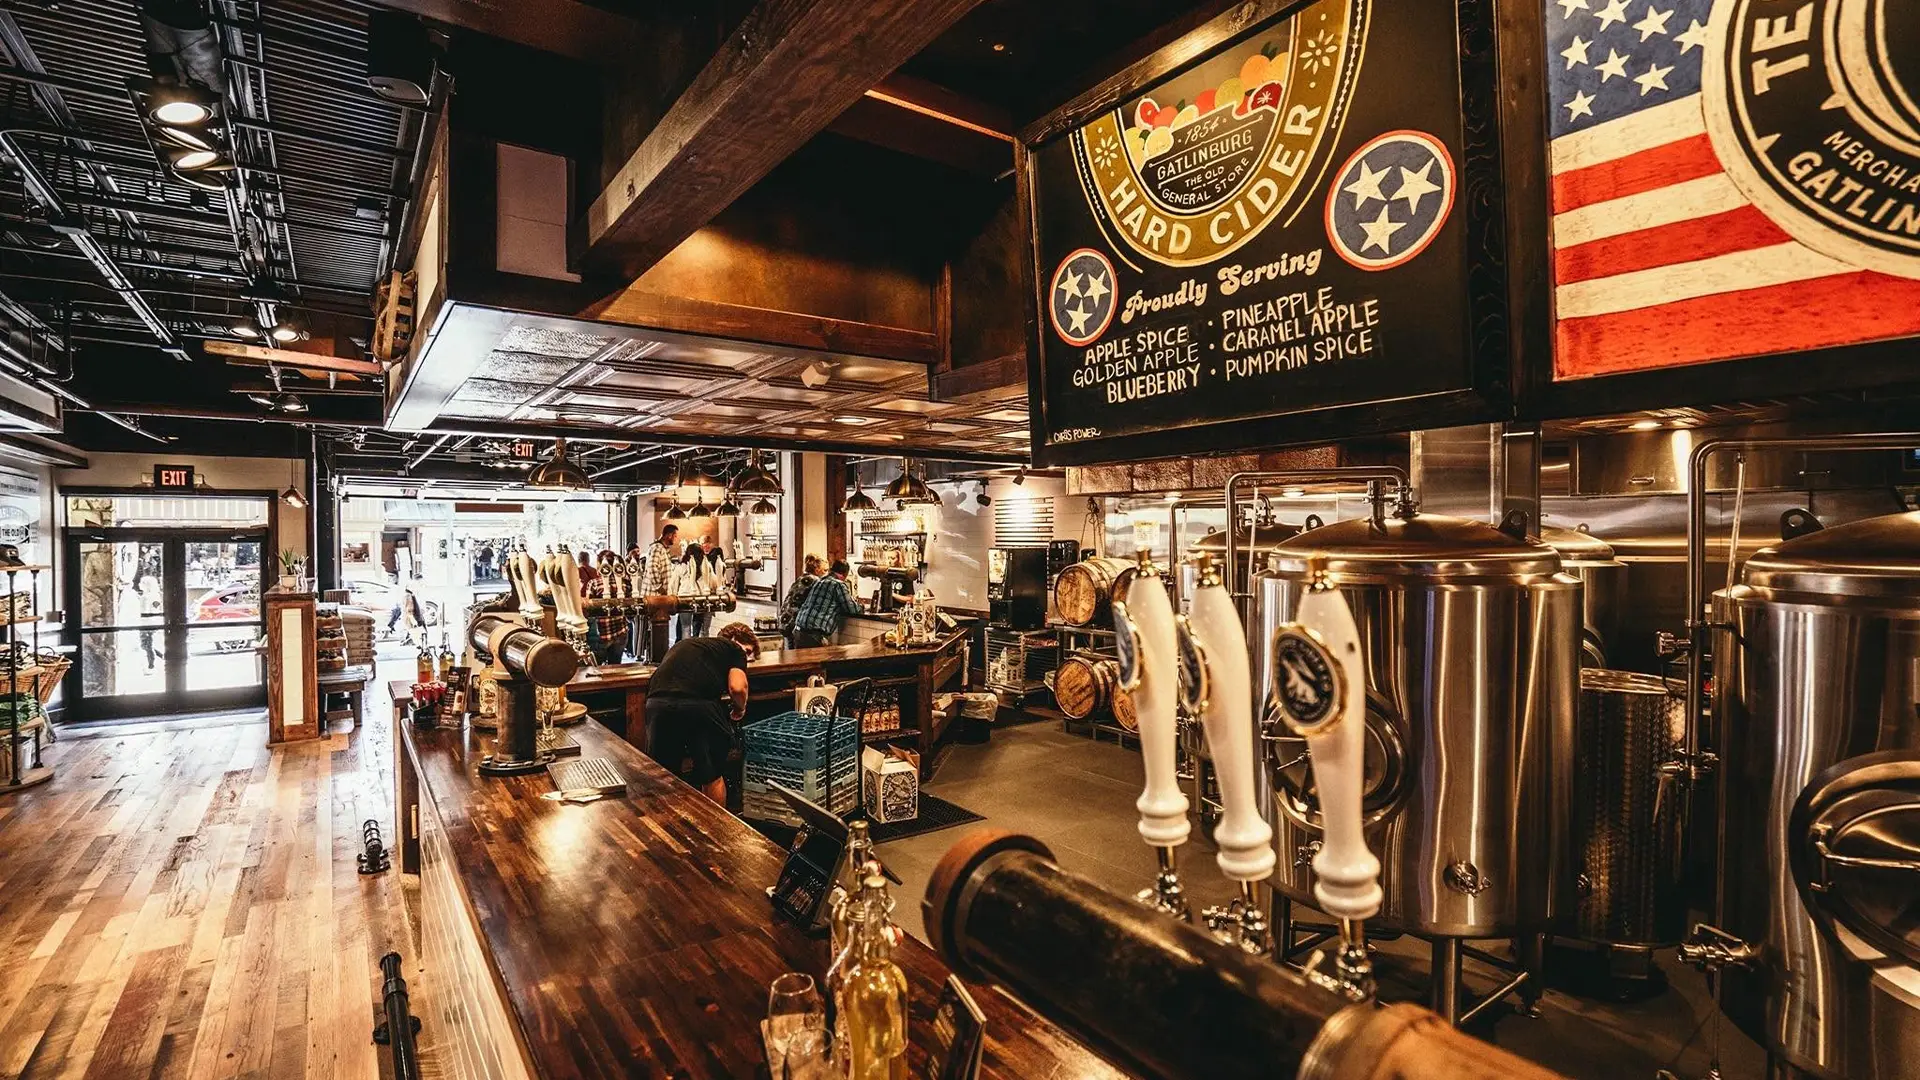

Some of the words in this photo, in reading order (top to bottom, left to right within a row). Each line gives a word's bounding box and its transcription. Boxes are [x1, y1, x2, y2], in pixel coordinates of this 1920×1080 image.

[1184, 116, 1220, 145] 1854
[1157, 129, 1252, 180] GATLINBURG
[1184, 173, 1203, 188] THE
[1205, 166, 1225, 180] OLD
[1110, 176, 1192, 254] HARD
[1209, 103, 1322, 245] CIDER
[1161, 188, 1212, 205] GENERAL
[1215, 157, 1250, 193] STORE
[1121, 278, 1208, 324] Proudly
[1217, 248, 1323, 296] Serving
[1221, 286, 1333, 330] PINEAPPLE
[1085, 338, 1132, 366] APPLE
[1137, 326, 1188, 353] SPICE
[1222, 318, 1306, 352] CARAMEL
[1311, 299, 1380, 337] APPLE
[1073, 356, 1137, 388] GOLDEN
[1143, 342, 1200, 371] APPLE
[1225, 344, 1308, 381] PUMPKIN
[1314, 329, 1373, 362] SPICE
[1107, 363, 1201, 404] BLUEBERRY
[515, 443, 534, 457] EXIT
[161, 470, 187, 486] EXIT
